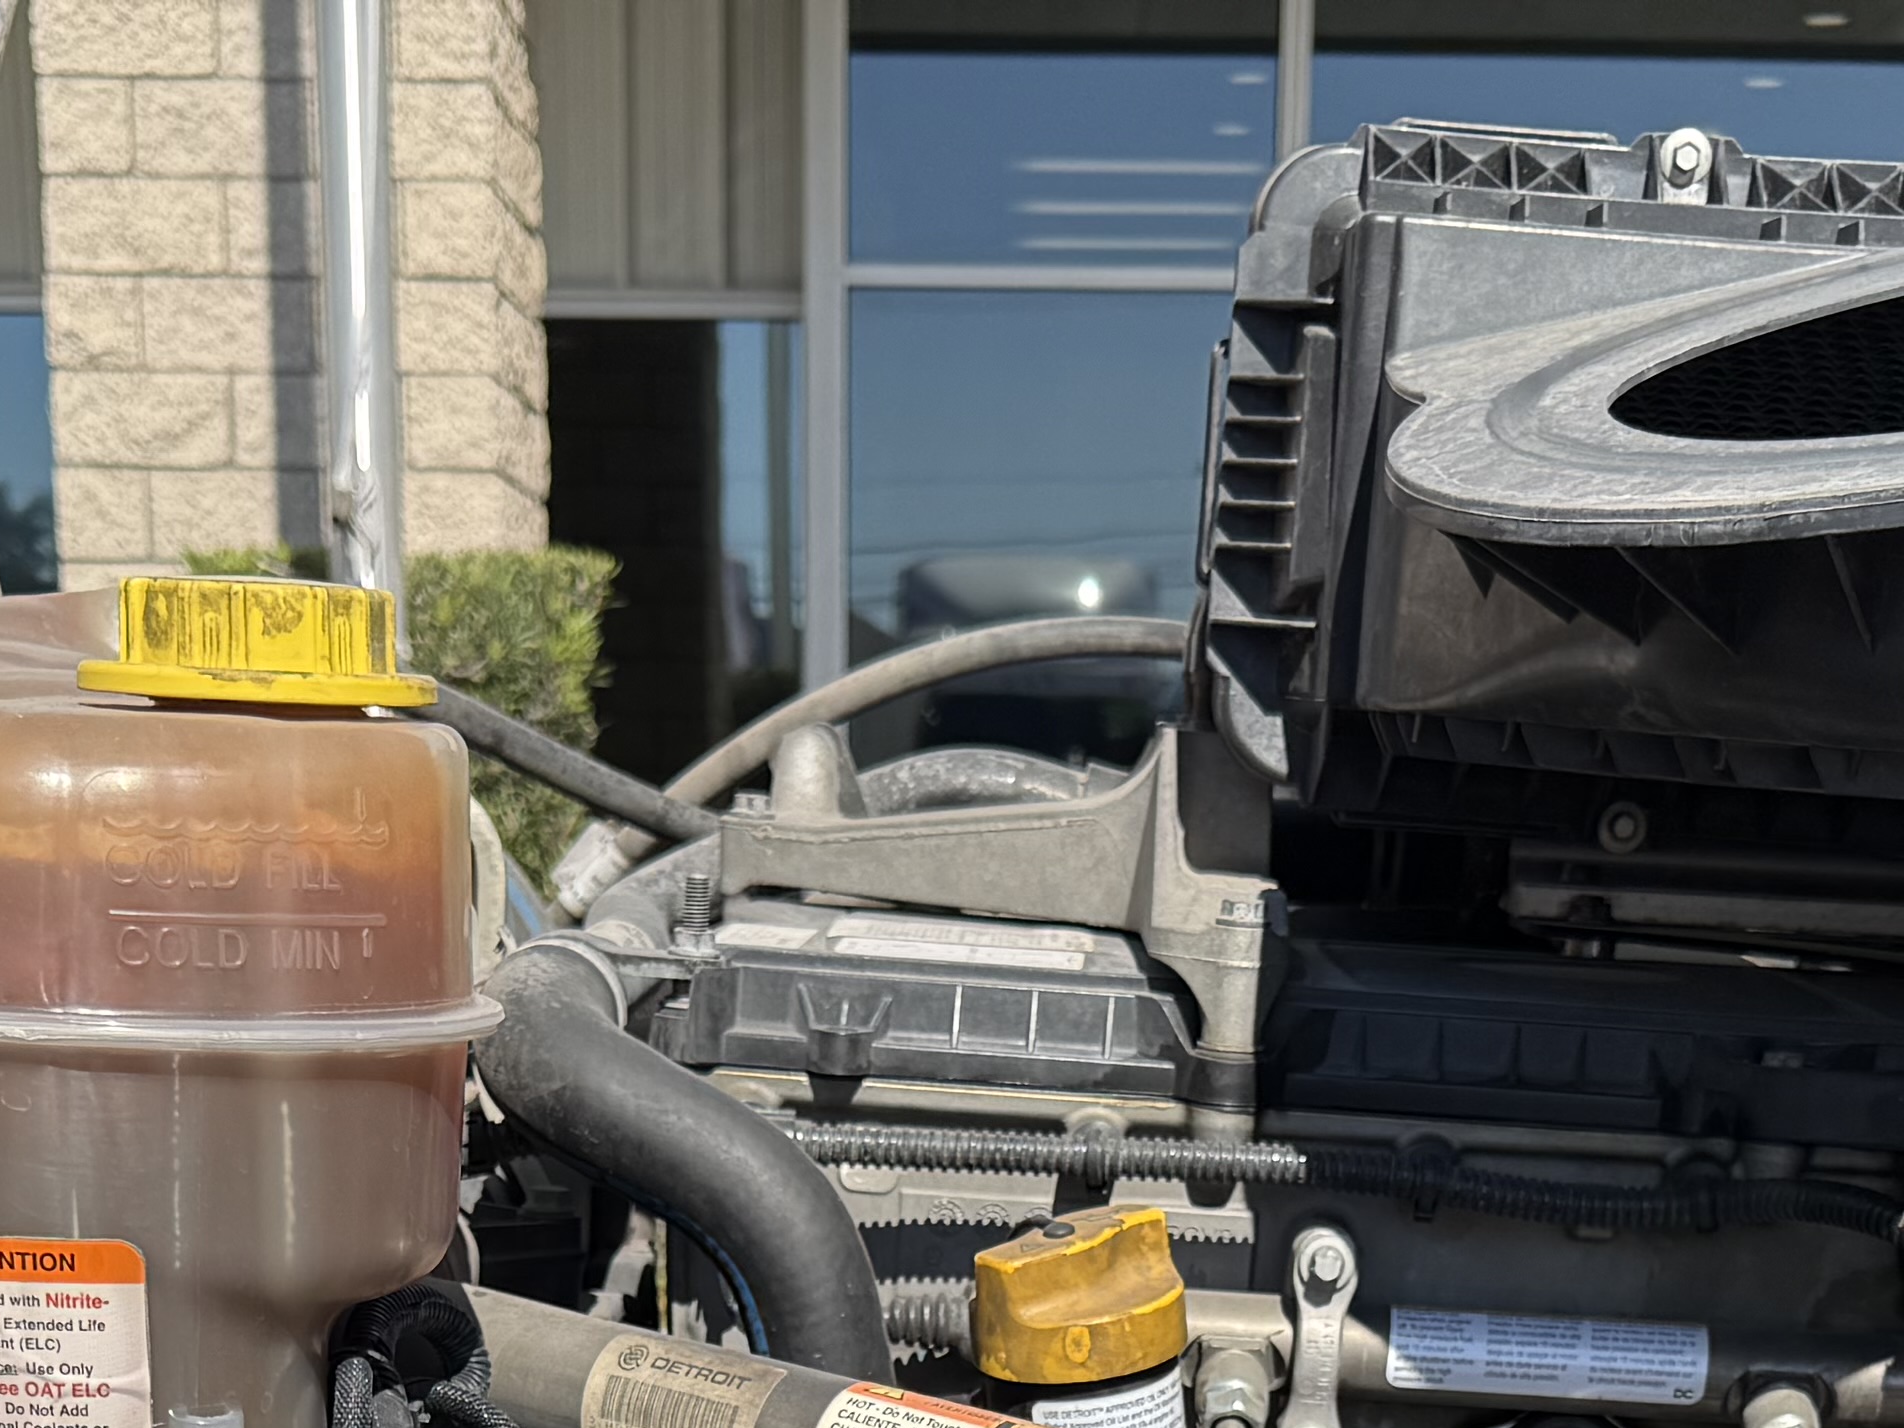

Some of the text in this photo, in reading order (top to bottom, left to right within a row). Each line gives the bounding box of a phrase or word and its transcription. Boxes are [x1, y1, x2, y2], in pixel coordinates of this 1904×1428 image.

[105, 843, 343, 893] COLD FILL
[115, 925, 342, 971] COLD MIN
[9, 1294, 41, 1308] with
[45, 1293, 110, 1310] Nitrite-
[3, 1317, 74, 1332] Extended
[78, 1319, 106, 1332] Life
[19, 1337, 62, 1354] (ELC)
[25, 1363, 55, 1376] Use
[59, 1362, 94, 1378] Only
[650, 1356, 752, 1391] DETROIT
[25, 1382, 65, 1399] OAT
[72, 1383, 111, 1399] ELC
[1673, 1389, 1694, 1401] DC
[5, 1402, 25, 1416] Do
[28, 1404, 55, 1418] Not
[60, 1404, 89, 1418] Add
[847, 1397, 874, 1411] HOT
[882, 1407, 901, 1419] Do
[902, 1411, 925, 1425] Not
